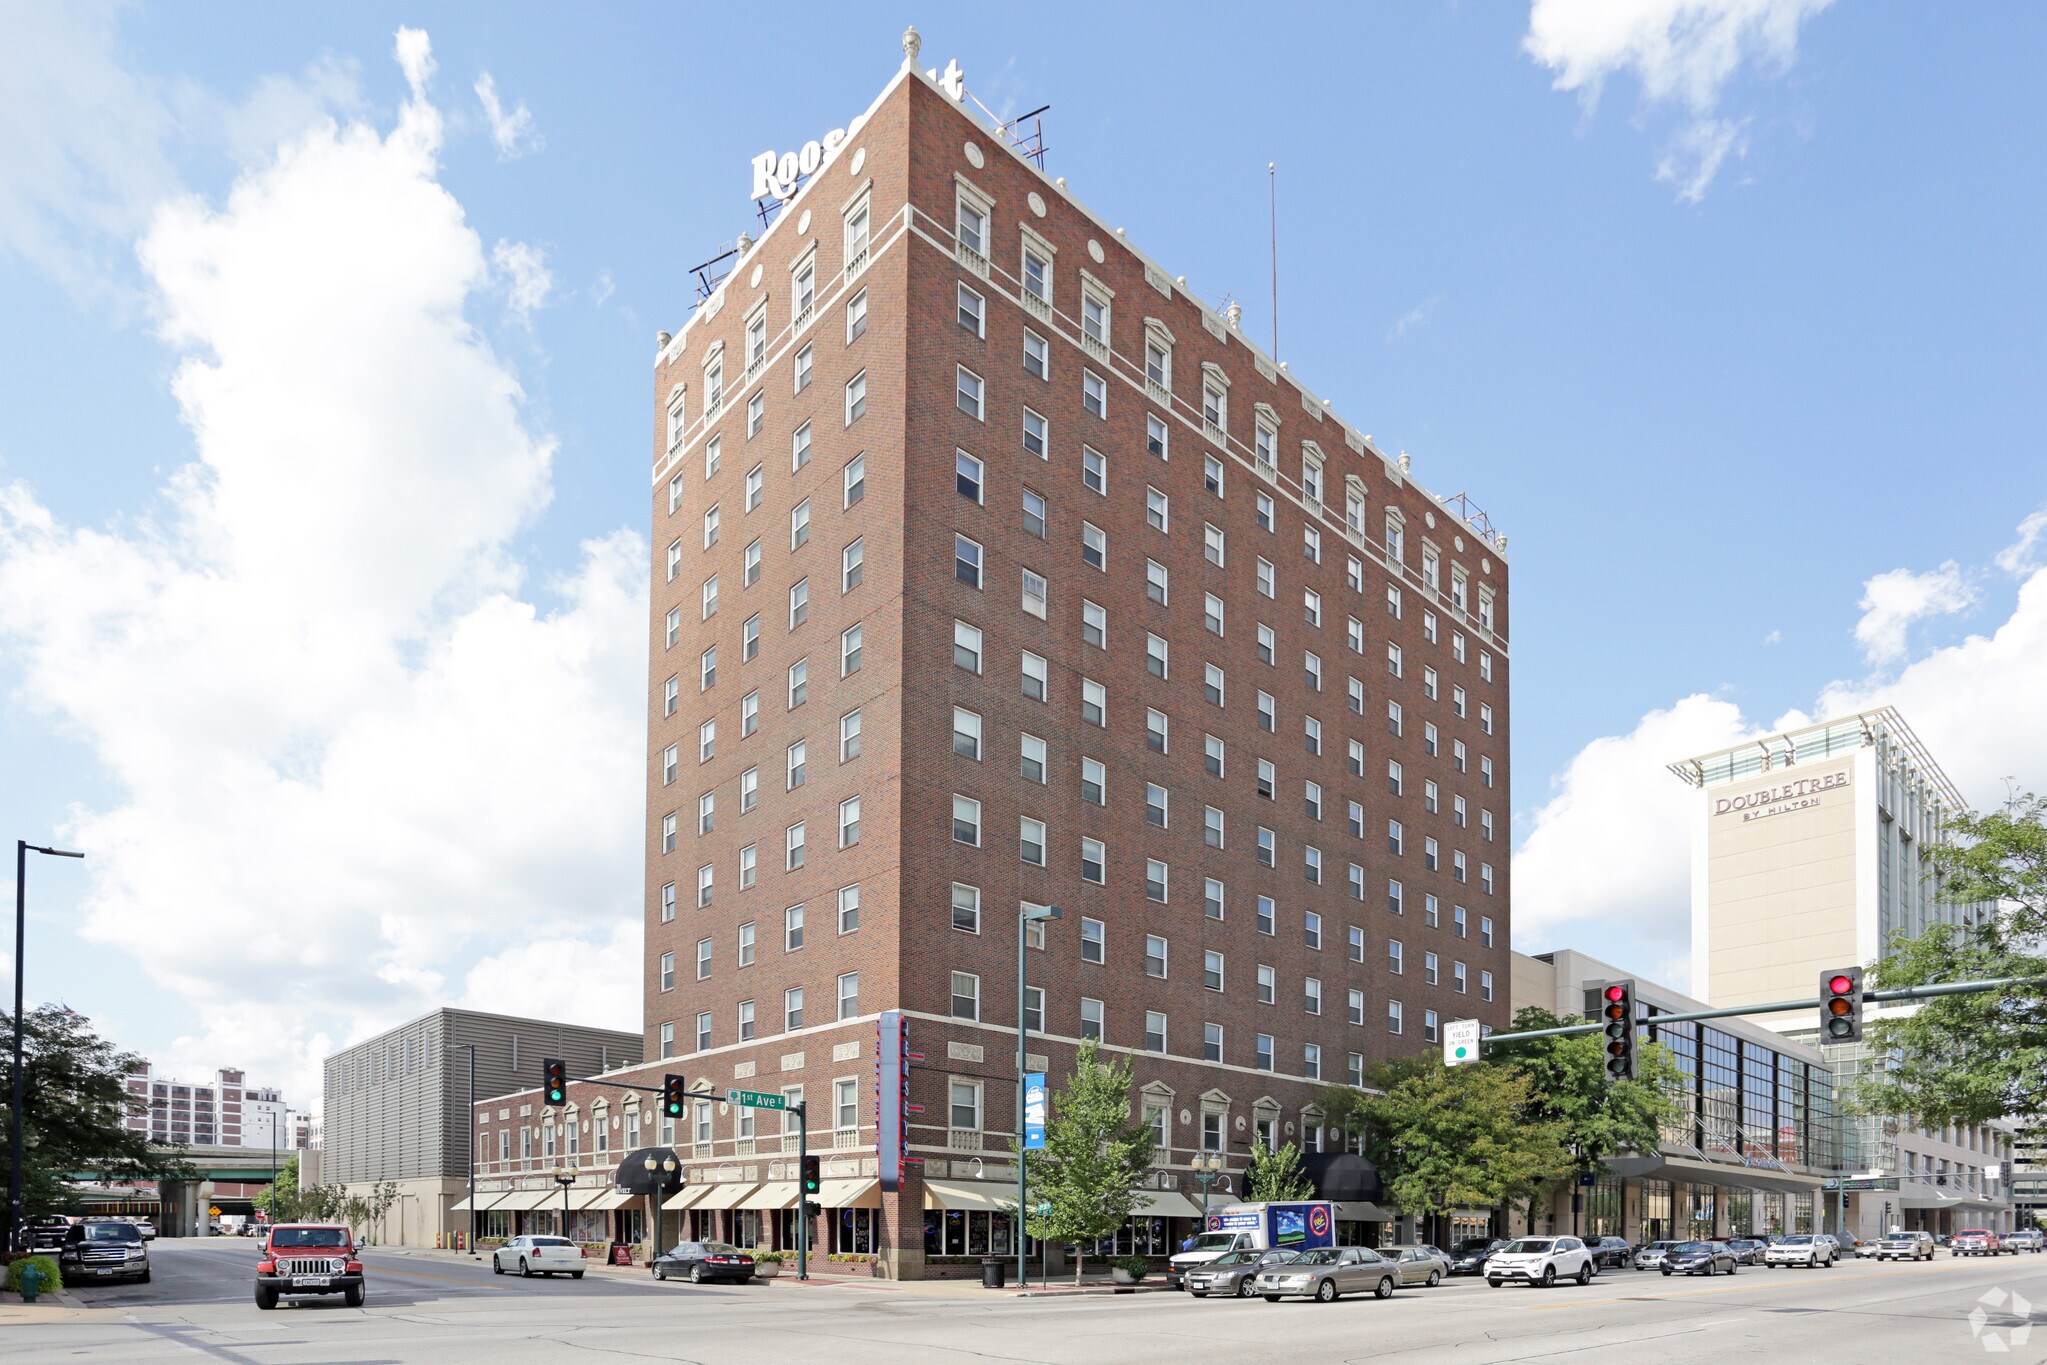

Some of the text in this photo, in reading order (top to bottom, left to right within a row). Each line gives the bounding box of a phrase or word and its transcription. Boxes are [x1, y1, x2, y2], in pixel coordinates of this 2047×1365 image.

[1743, 797, 1819, 820] BY HILTON
[741, 1093, 753, 1104] 1st
[756, 1095, 776, 1107] Ave
